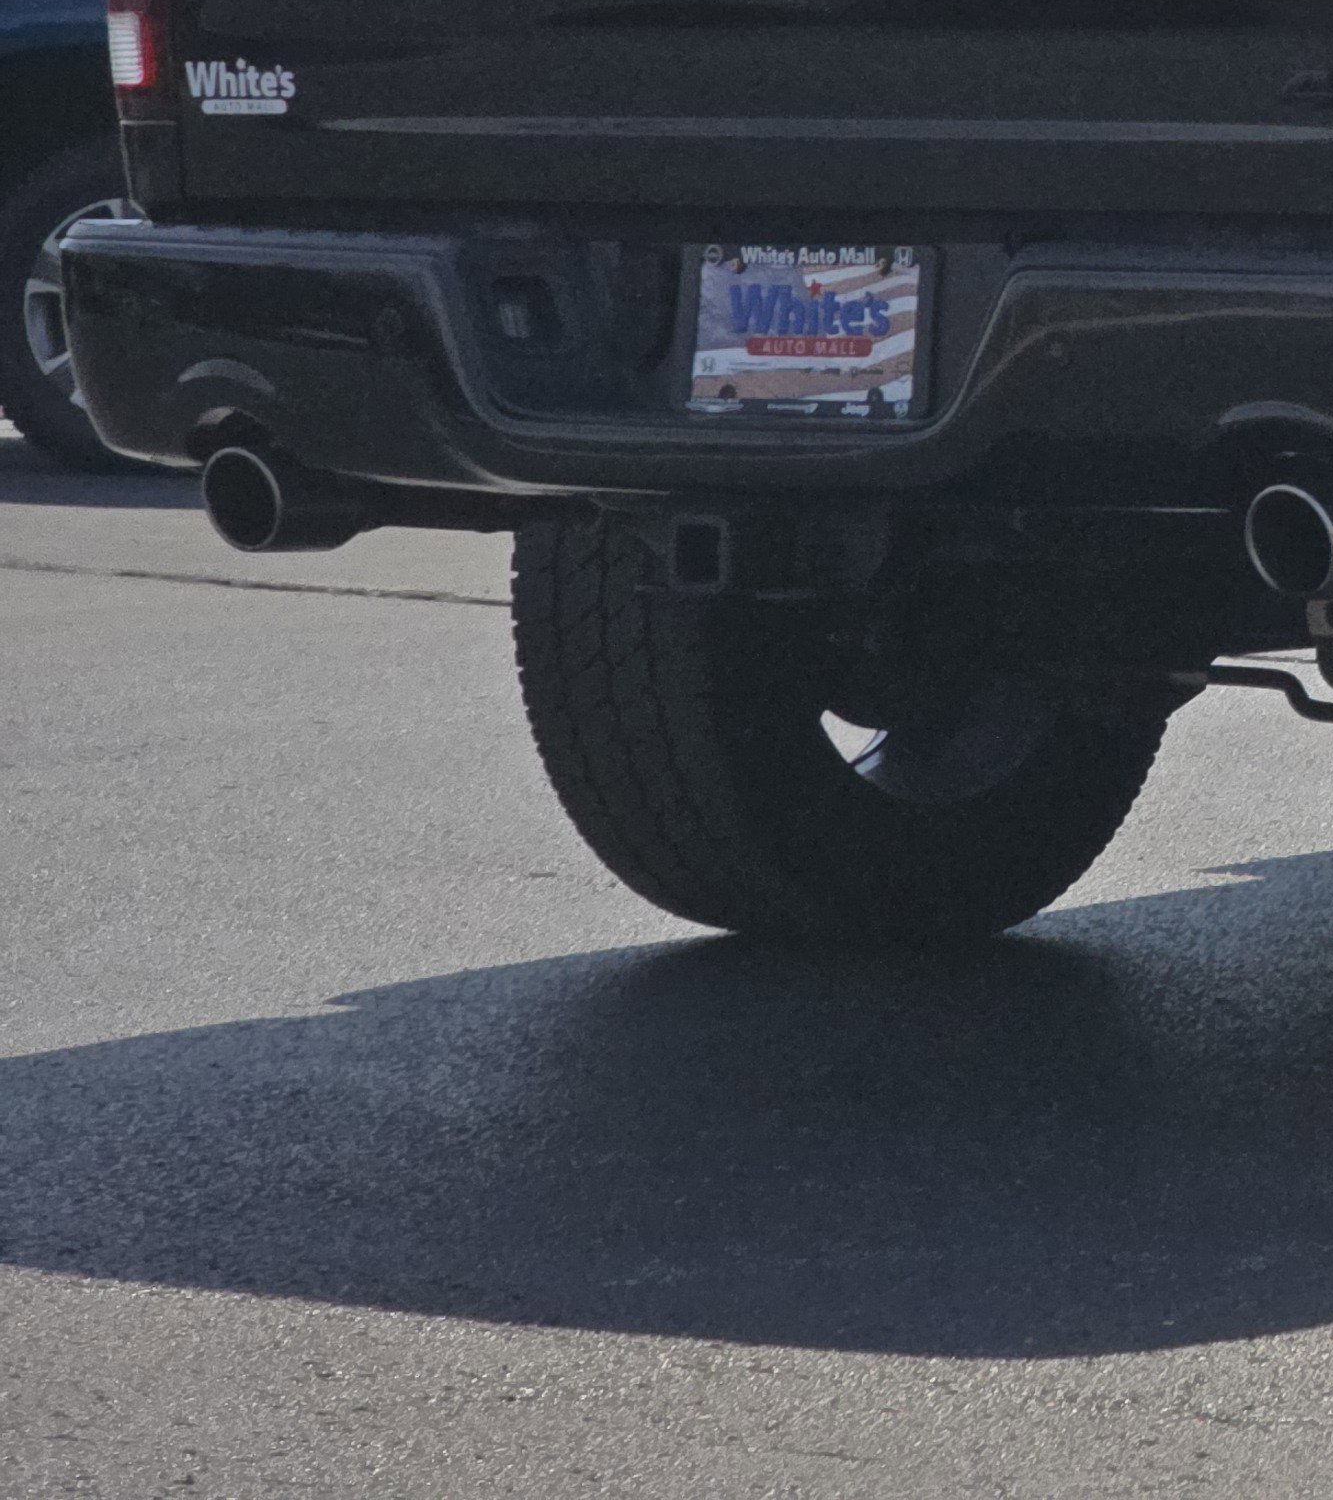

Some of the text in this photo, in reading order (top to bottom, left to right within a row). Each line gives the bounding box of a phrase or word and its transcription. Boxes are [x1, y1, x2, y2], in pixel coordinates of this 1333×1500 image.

[184, 57, 297, 98] White's
[740, 246, 876, 265] White's Auto Mall
[730, 280, 892, 336] White's
[762, 339, 857, 356] AUTO MALL
